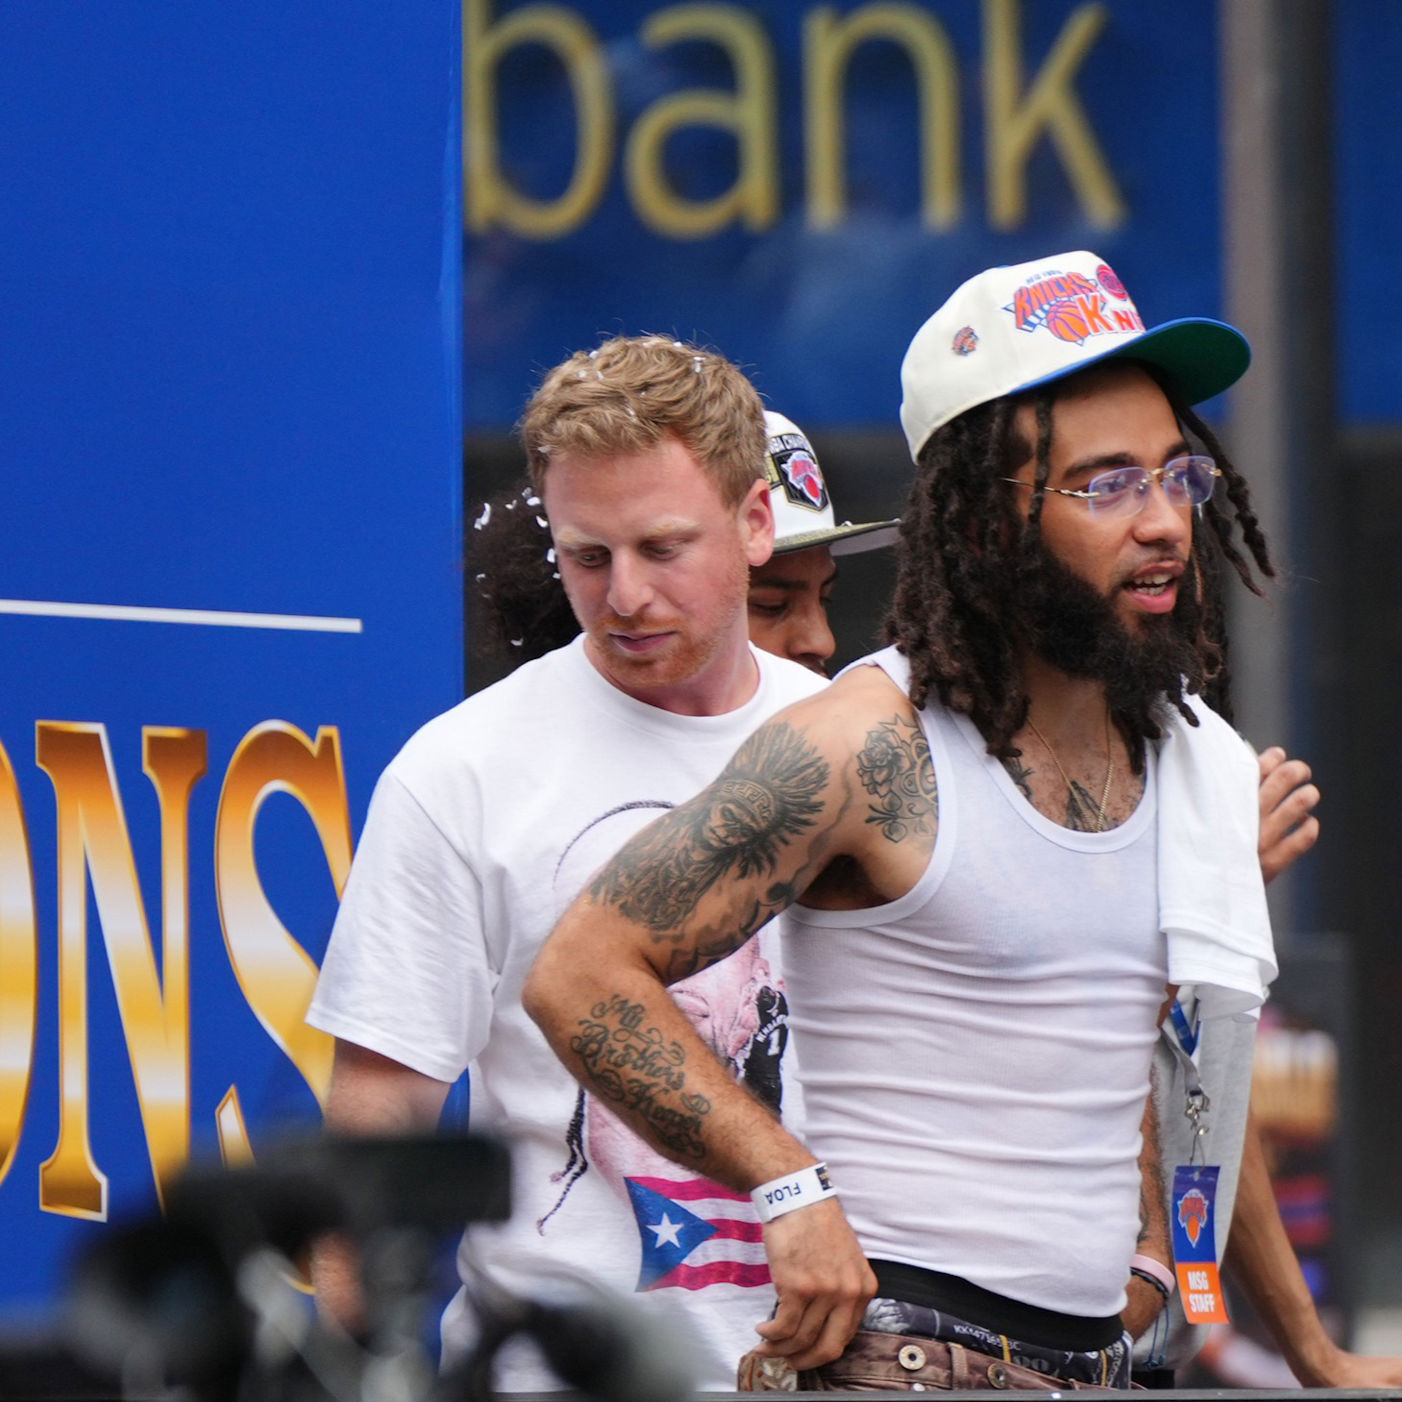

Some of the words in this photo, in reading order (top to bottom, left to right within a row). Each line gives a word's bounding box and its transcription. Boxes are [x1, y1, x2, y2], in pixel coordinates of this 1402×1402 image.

[461, 0, 1127, 239] bank
[0, 719, 354, 1224] NS
[1187, 1271, 1209, 1290] MSG
[1188, 1294, 1215, 1313] STAFF
